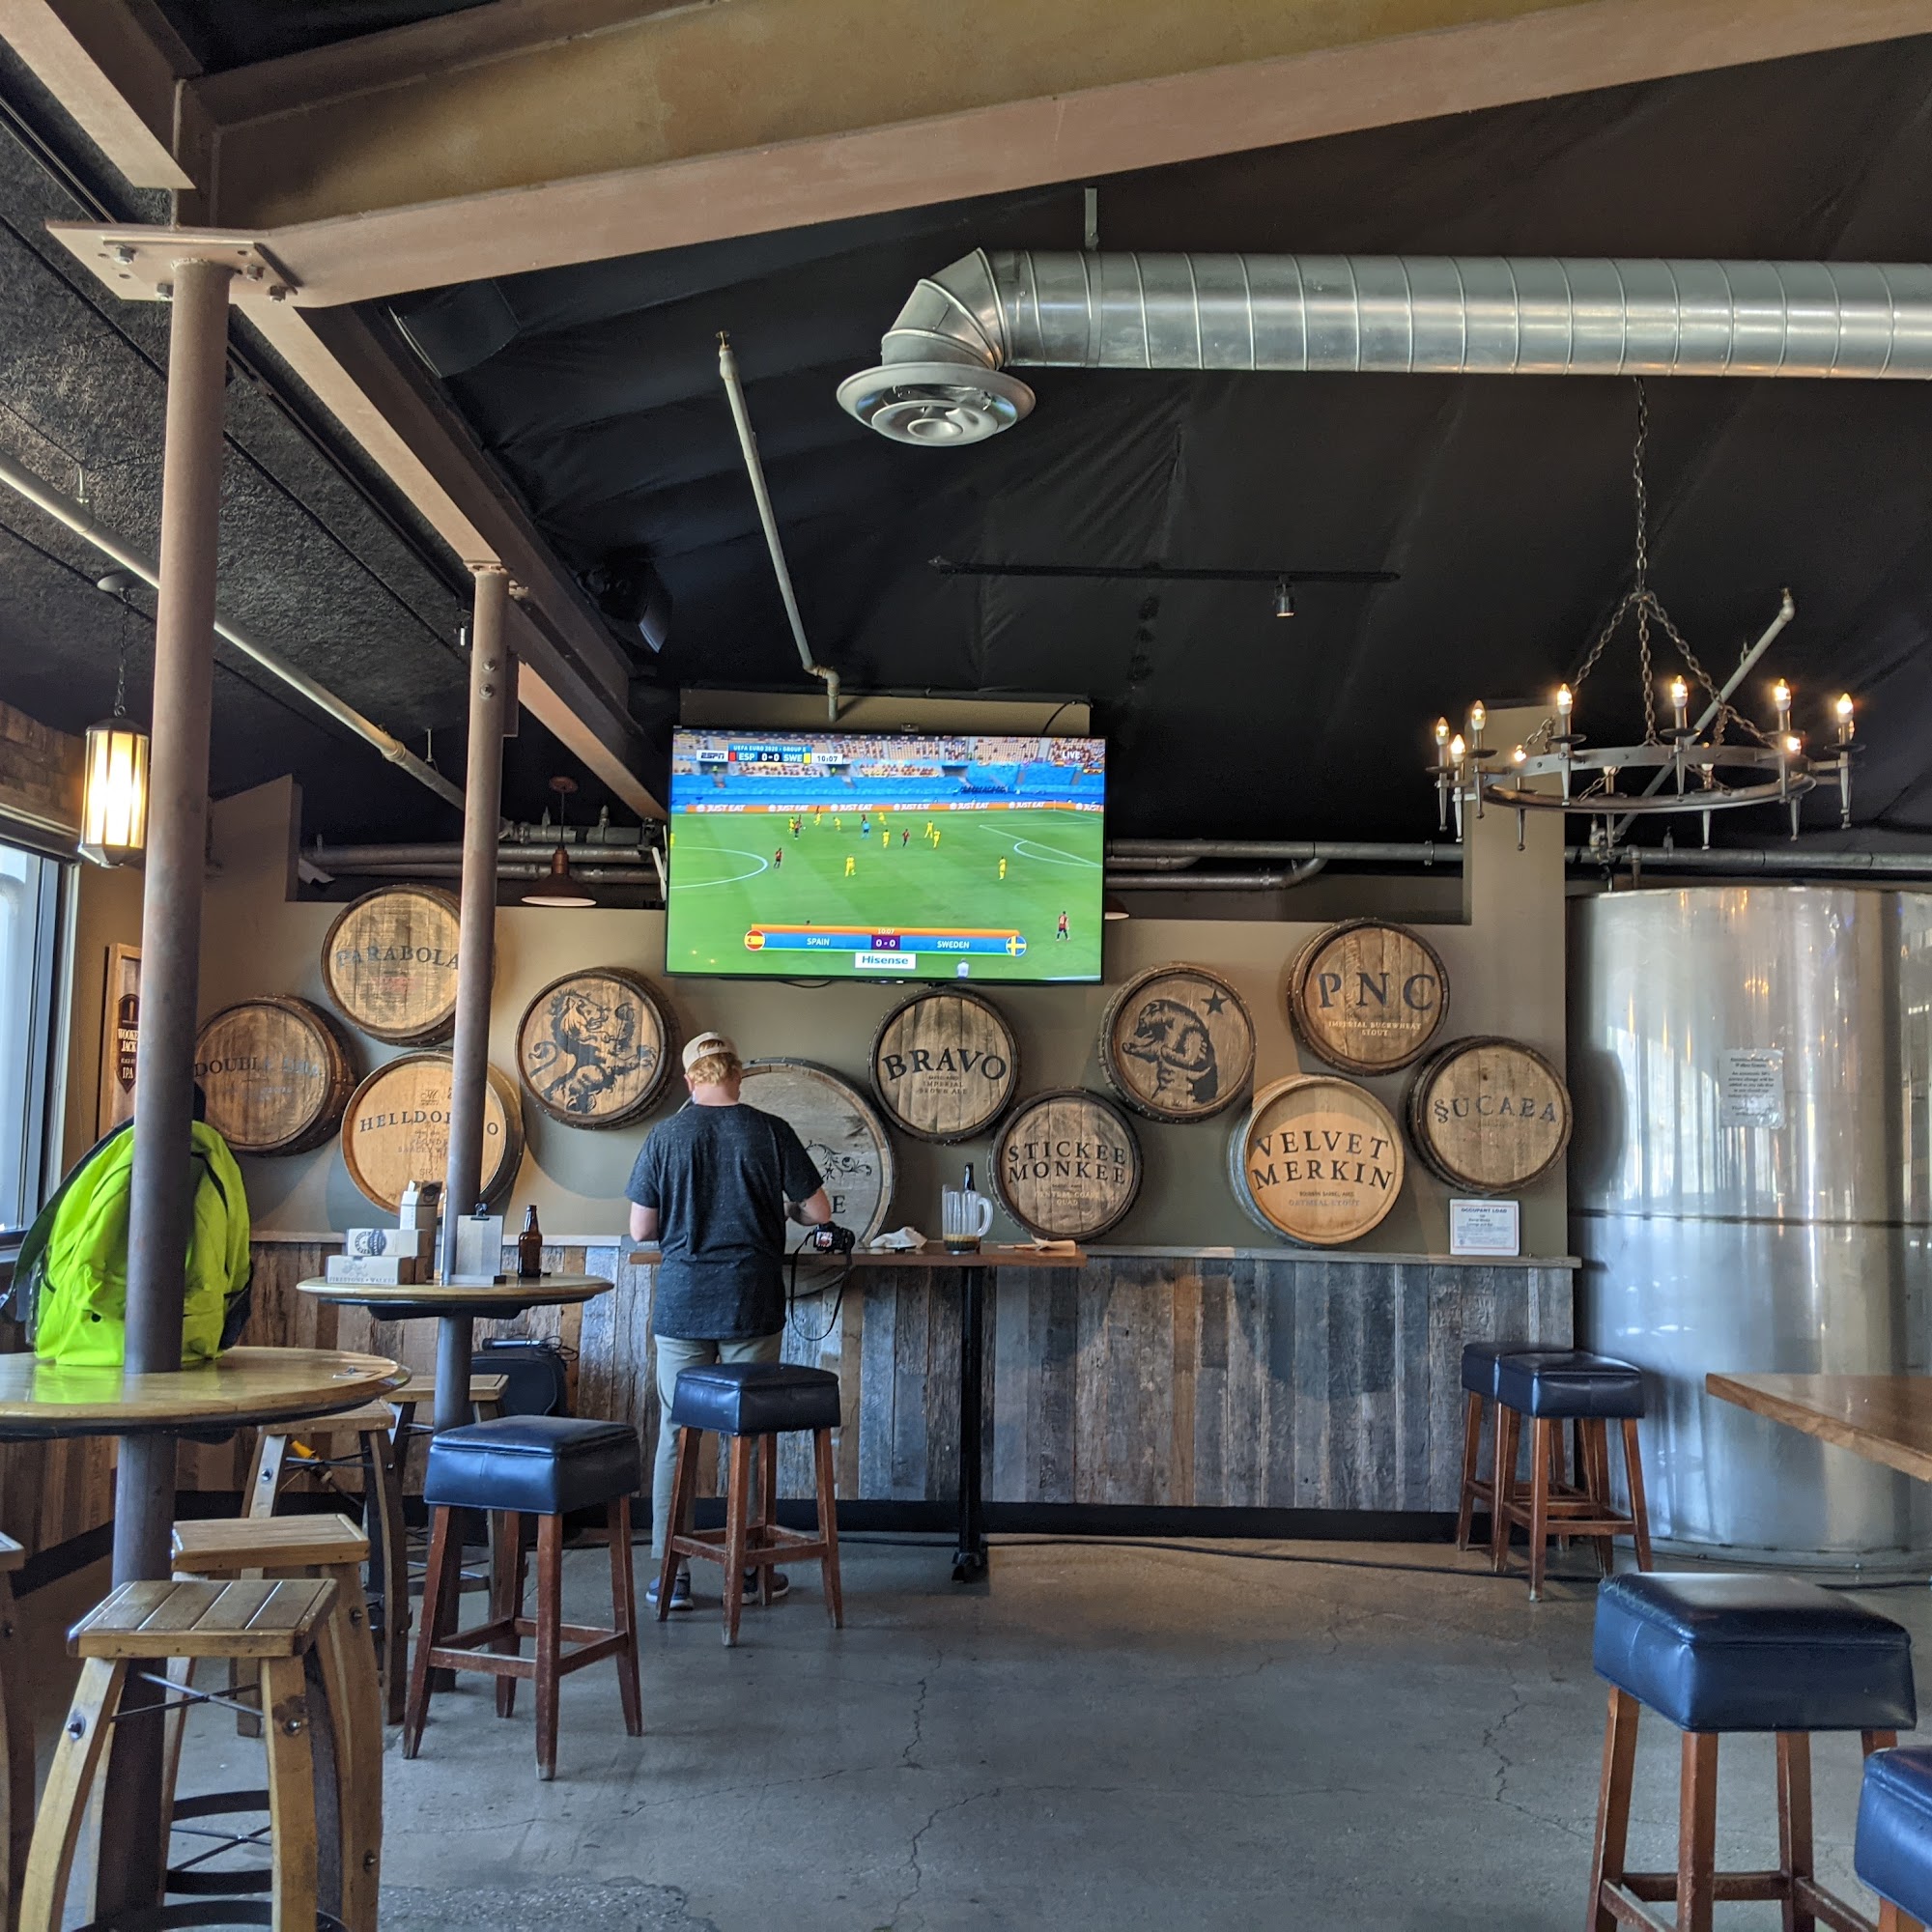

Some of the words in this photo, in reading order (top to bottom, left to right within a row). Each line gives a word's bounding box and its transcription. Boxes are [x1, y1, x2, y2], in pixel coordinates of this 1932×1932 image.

[738, 753, 755, 761] ESP
[1063, 751, 1081, 759] LIVE
[862, 955, 908, 964] Hisense
[1318, 972, 1435, 1011] PNC
[118, 1028, 139, 1040] WOOKE
[1370, 1021, 1422, 1030] BUCKWHEAT
[121, 1040, 137, 1052] JACK
[123, 1066, 133, 1079] IPA
[881, 1047, 1007, 1081] BRAVO
[360, 1111, 498, 1135] HELLDOO
[1008, 1141, 1125, 1165] STICKEE
[1255, 1130, 1389, 1159] VELVET
[1008, 1160, 1125, 1184] MONKEE
[1252, 1159, 1394, 1190] MERKIN
